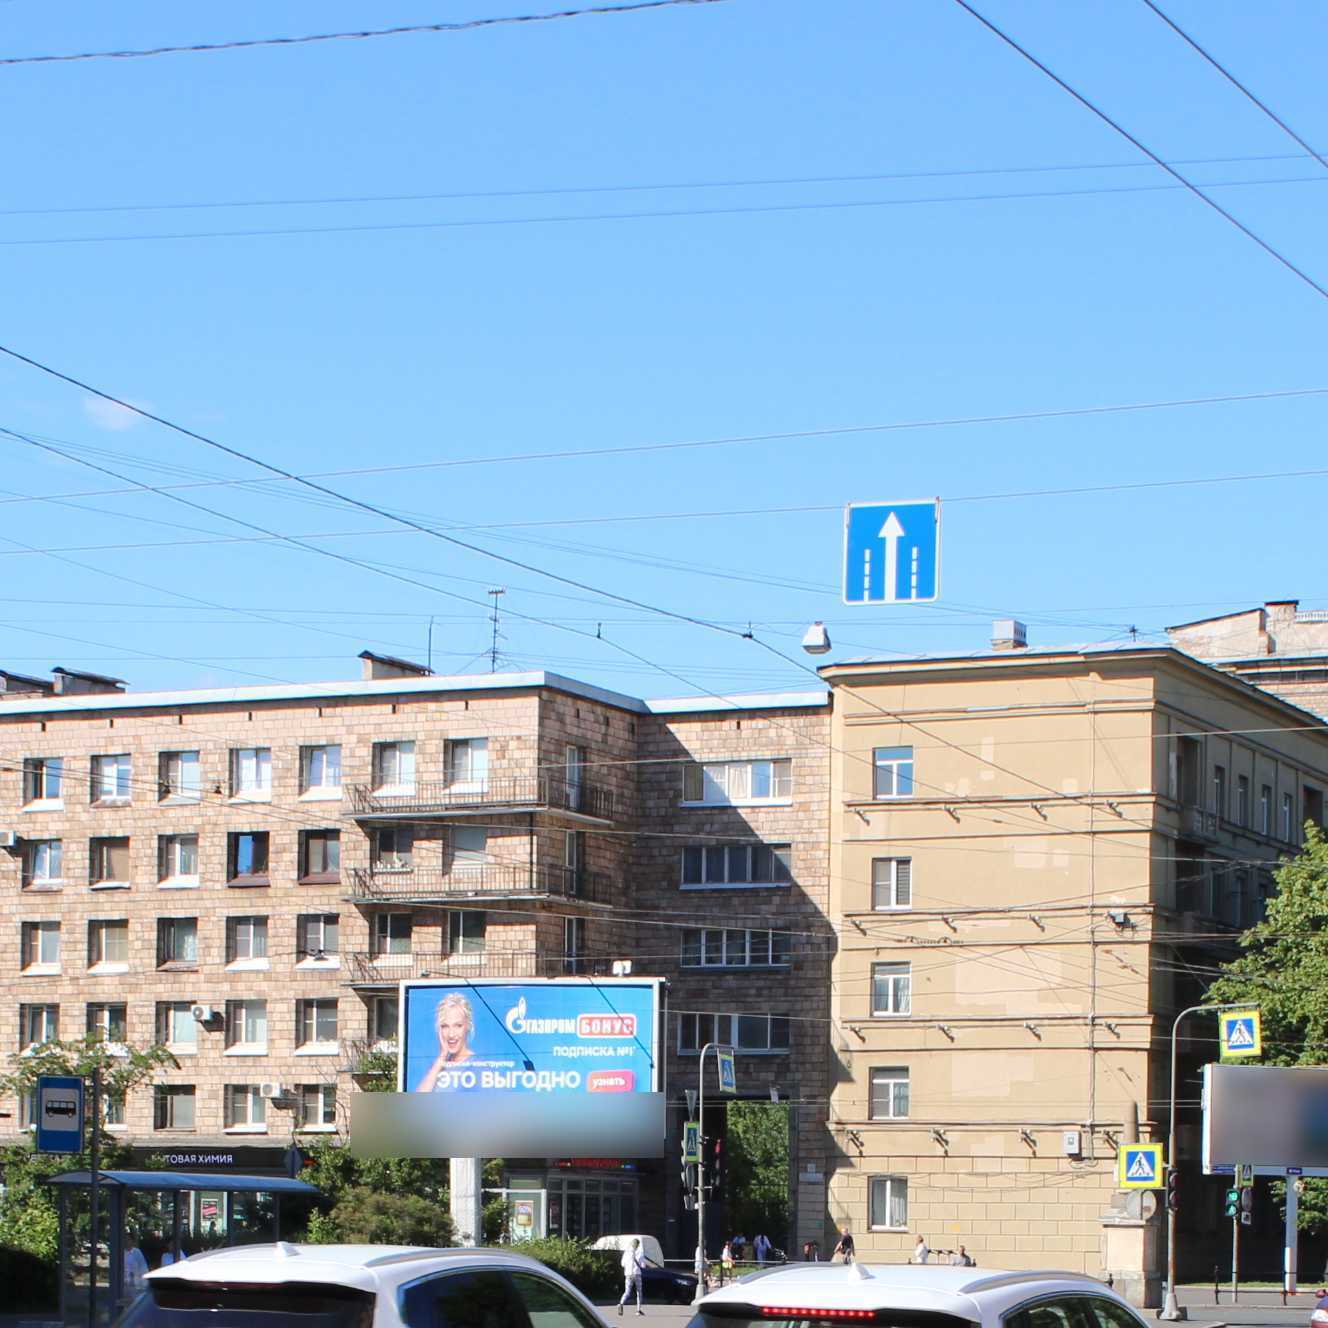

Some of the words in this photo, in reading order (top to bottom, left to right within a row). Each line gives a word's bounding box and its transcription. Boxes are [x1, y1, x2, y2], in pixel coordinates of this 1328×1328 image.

[526, 1018, 577, 1034] ГАЗПРОМ
[580, 1018, 632, 1034] БОНУС
[552, 1046, 615, 1058] ПОДПИСКА
[436, 1070, 477, 1089] ЭТО
[480, 1070, 582, 1092] ВЫГОДНО
[198, 1154, 233, 1164] ХИМИЯ
